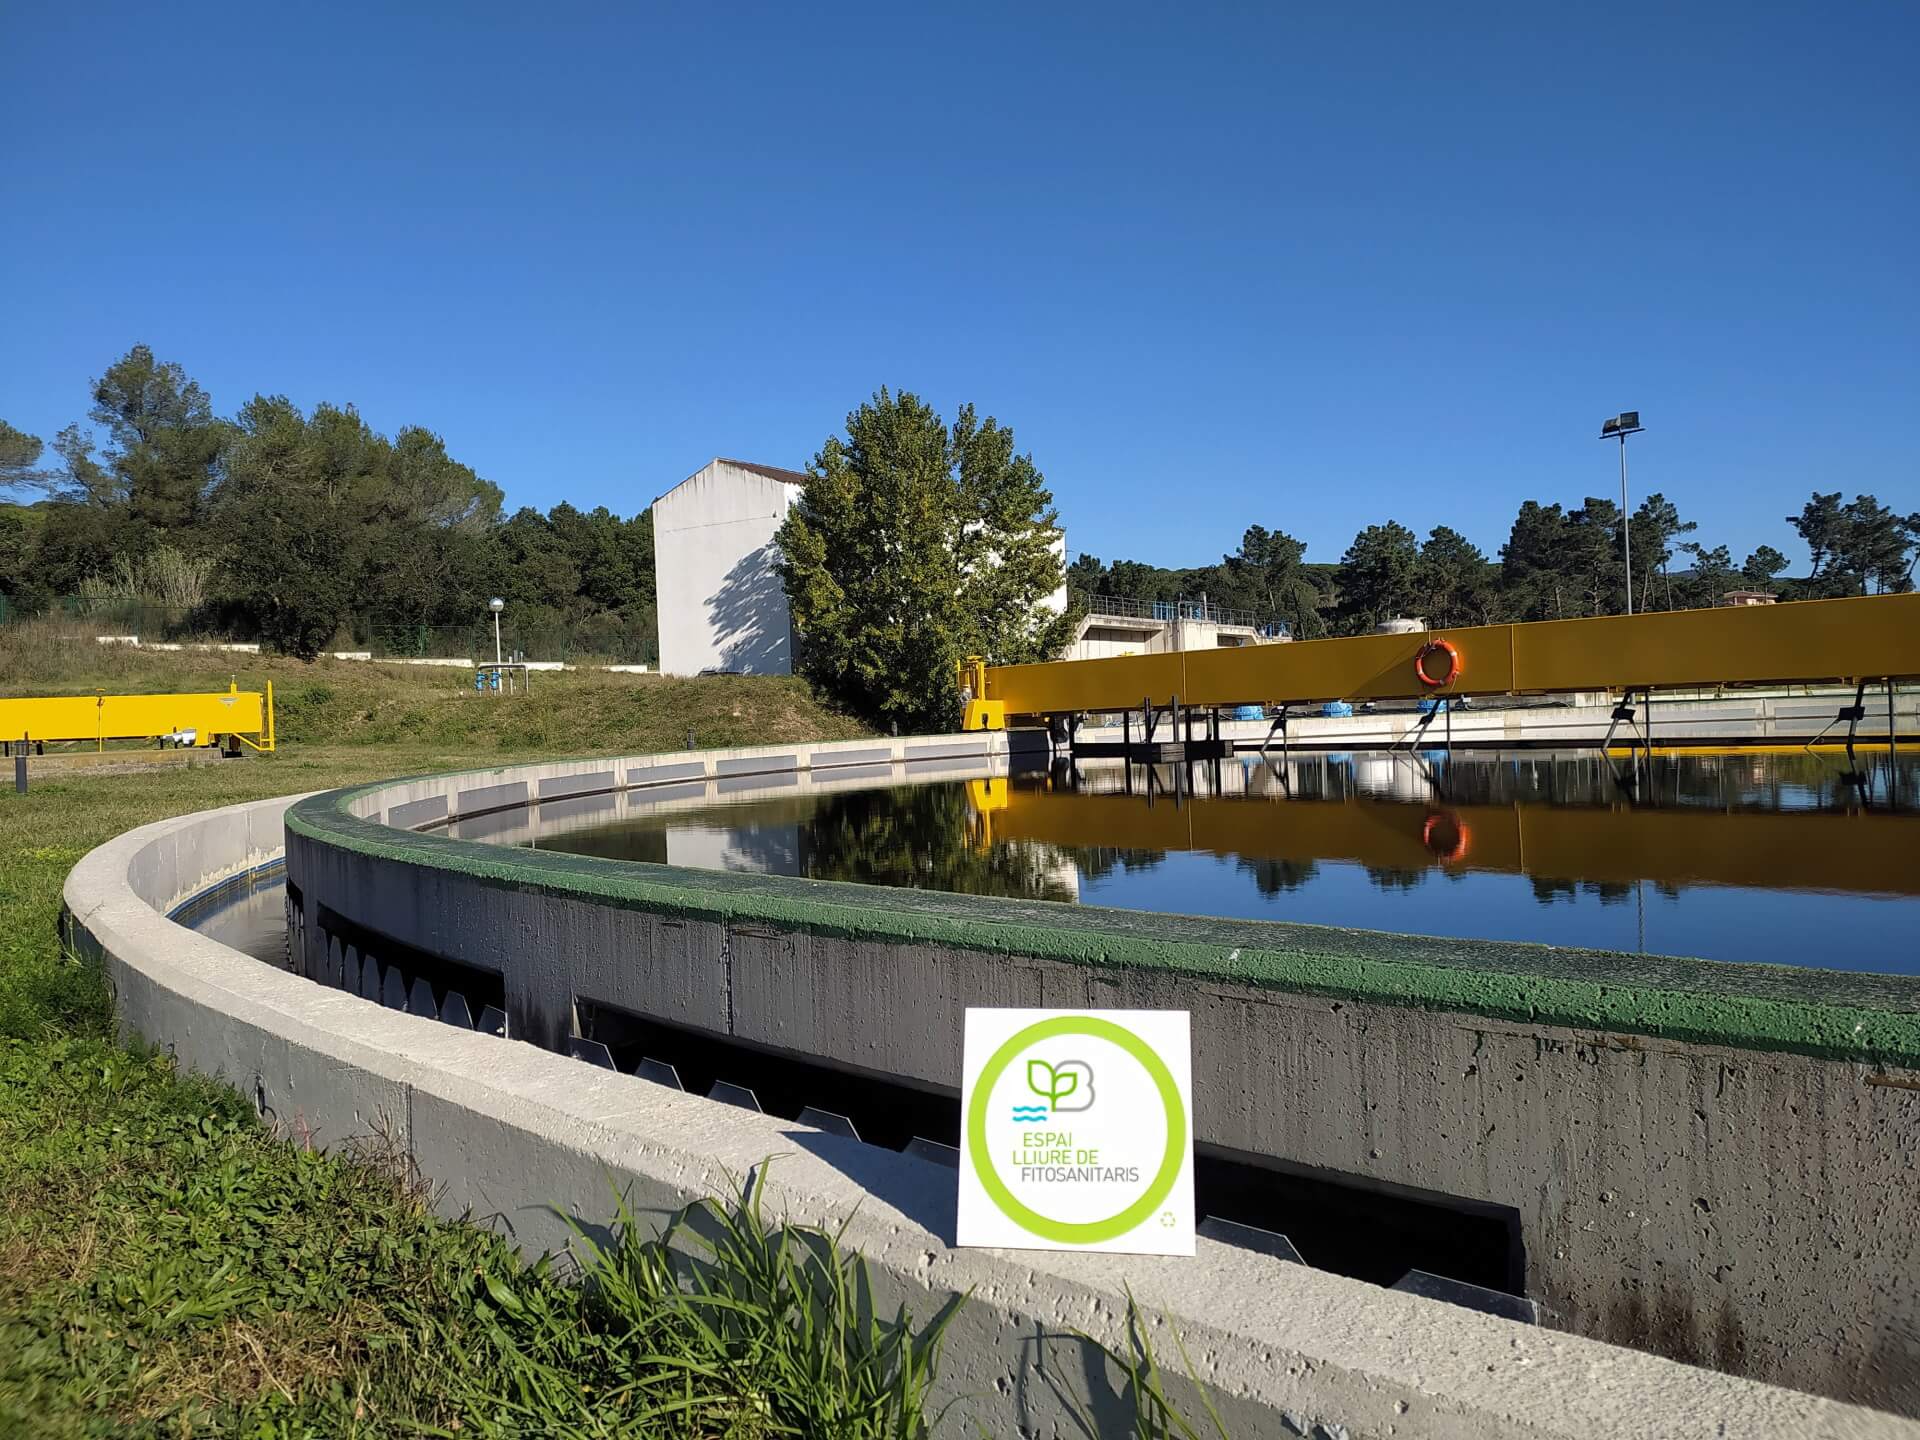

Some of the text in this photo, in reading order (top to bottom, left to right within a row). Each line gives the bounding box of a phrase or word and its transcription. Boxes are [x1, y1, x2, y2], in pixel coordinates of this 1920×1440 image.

[1023, 1132, 1072, 1147] ESPAI
[1012, 1150, 1099, 1165] LLIURE DE
[1021, 1167, 1139, 1183] FITOSANITARIS
